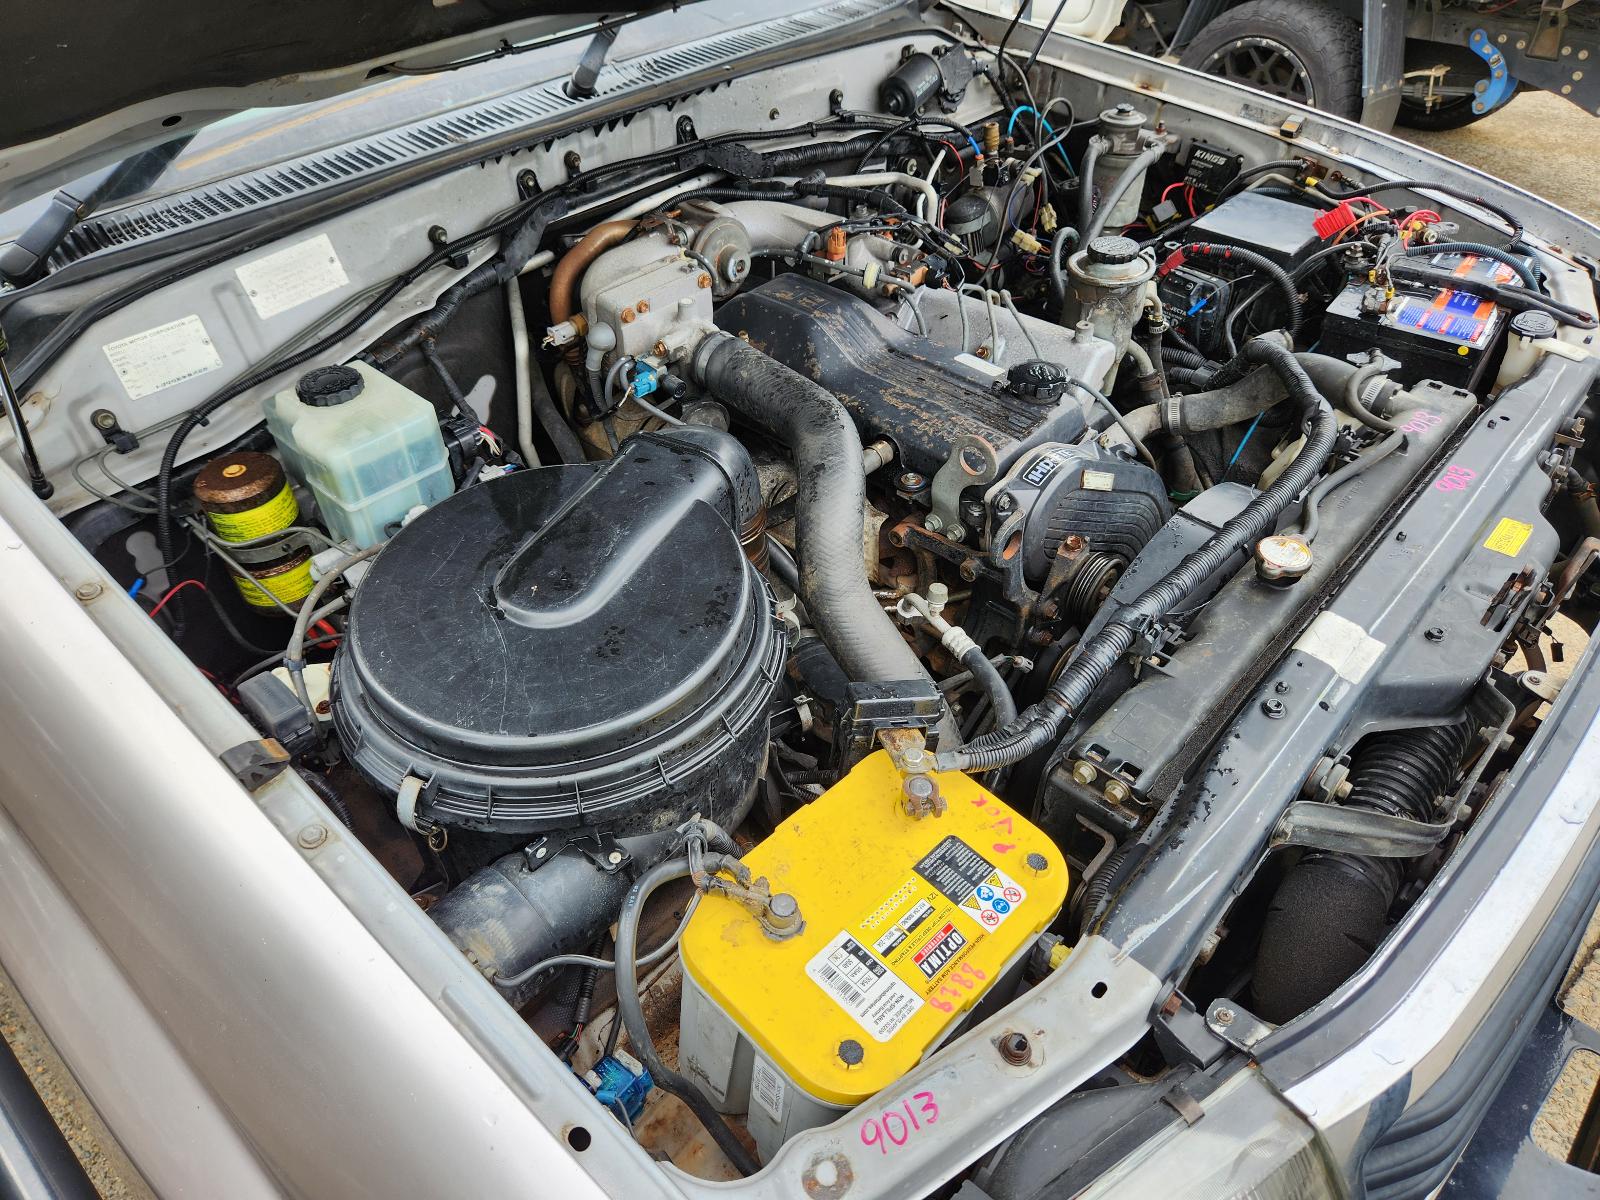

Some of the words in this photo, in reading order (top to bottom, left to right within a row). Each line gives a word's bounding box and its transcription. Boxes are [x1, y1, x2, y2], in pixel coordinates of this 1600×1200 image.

[1193, 149, 1228, 166] KINGS
[925, 891, 938, 902] 12V
[919, 931, 946, 956] BATTERIES
[919, 930, 965, 975] OPTIMA
[872, 993, 905, 1026] NON-SPILLABLE
[860, 1090, 940, 1154] 9013
